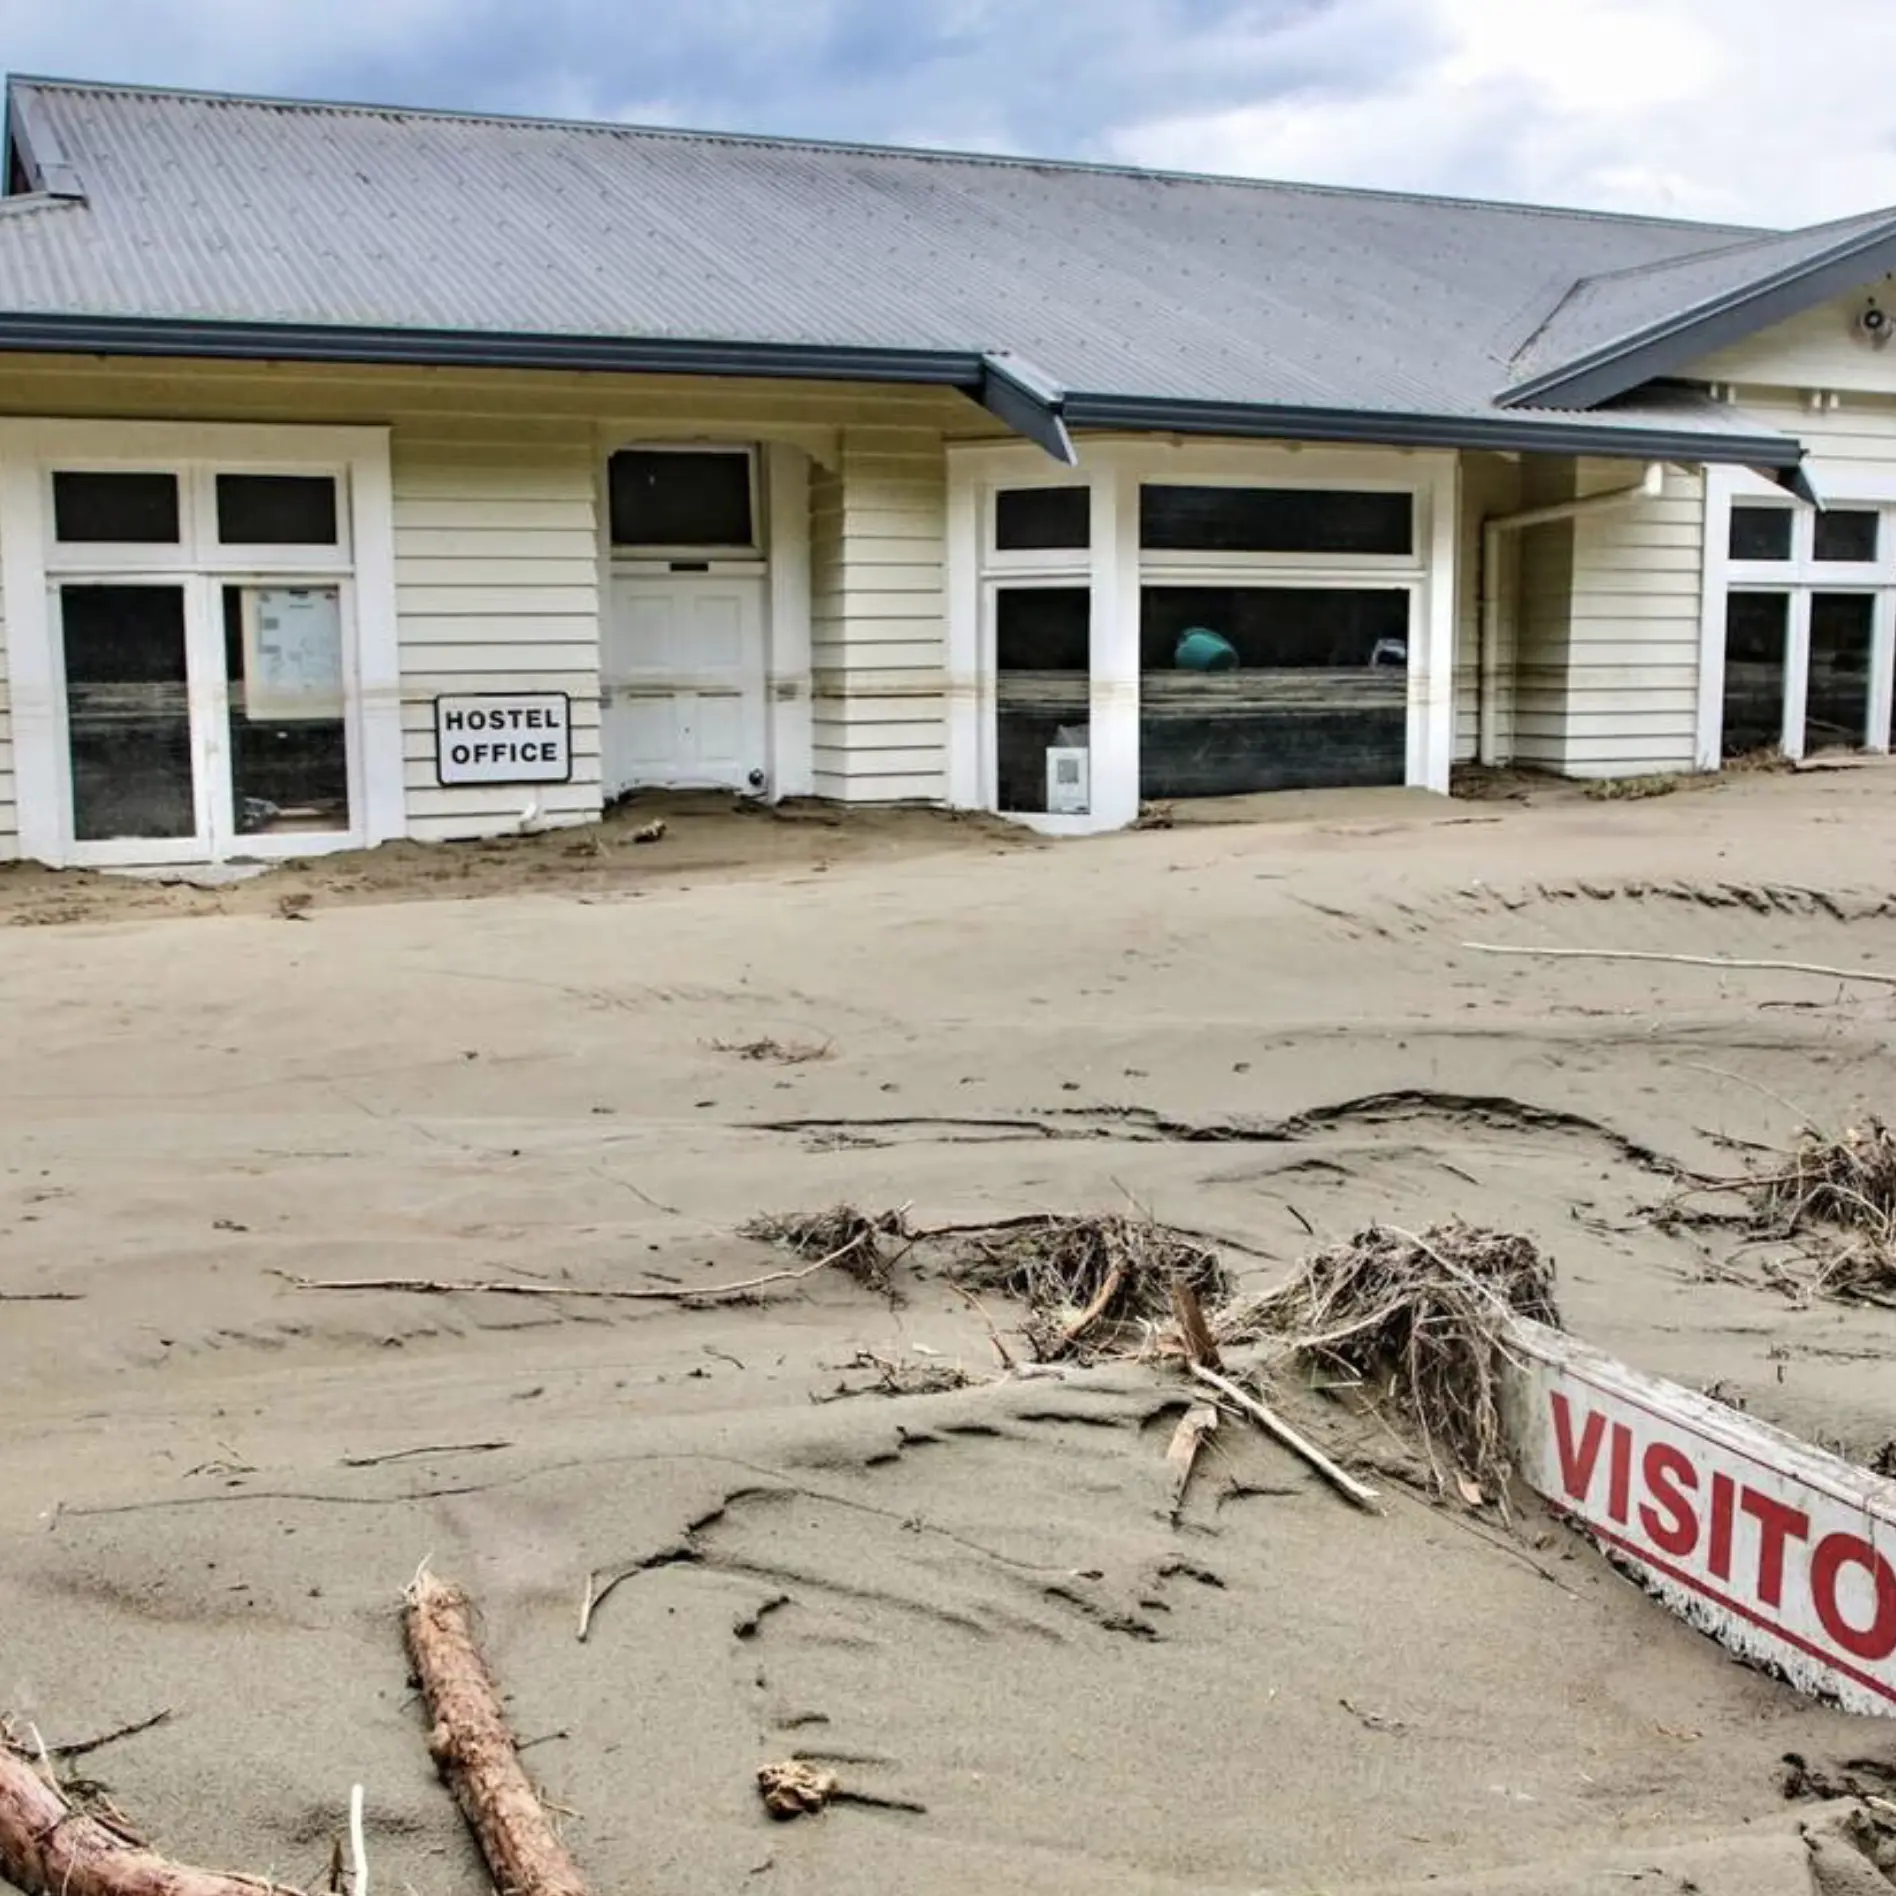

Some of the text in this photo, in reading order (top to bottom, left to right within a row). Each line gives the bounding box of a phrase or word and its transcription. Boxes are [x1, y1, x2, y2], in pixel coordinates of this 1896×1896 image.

[446, 708, 560, 730] HOSTEL
[452, 742, 557, 764] OFFICE
[1549, 1389, 1896, 1661] VISITO
